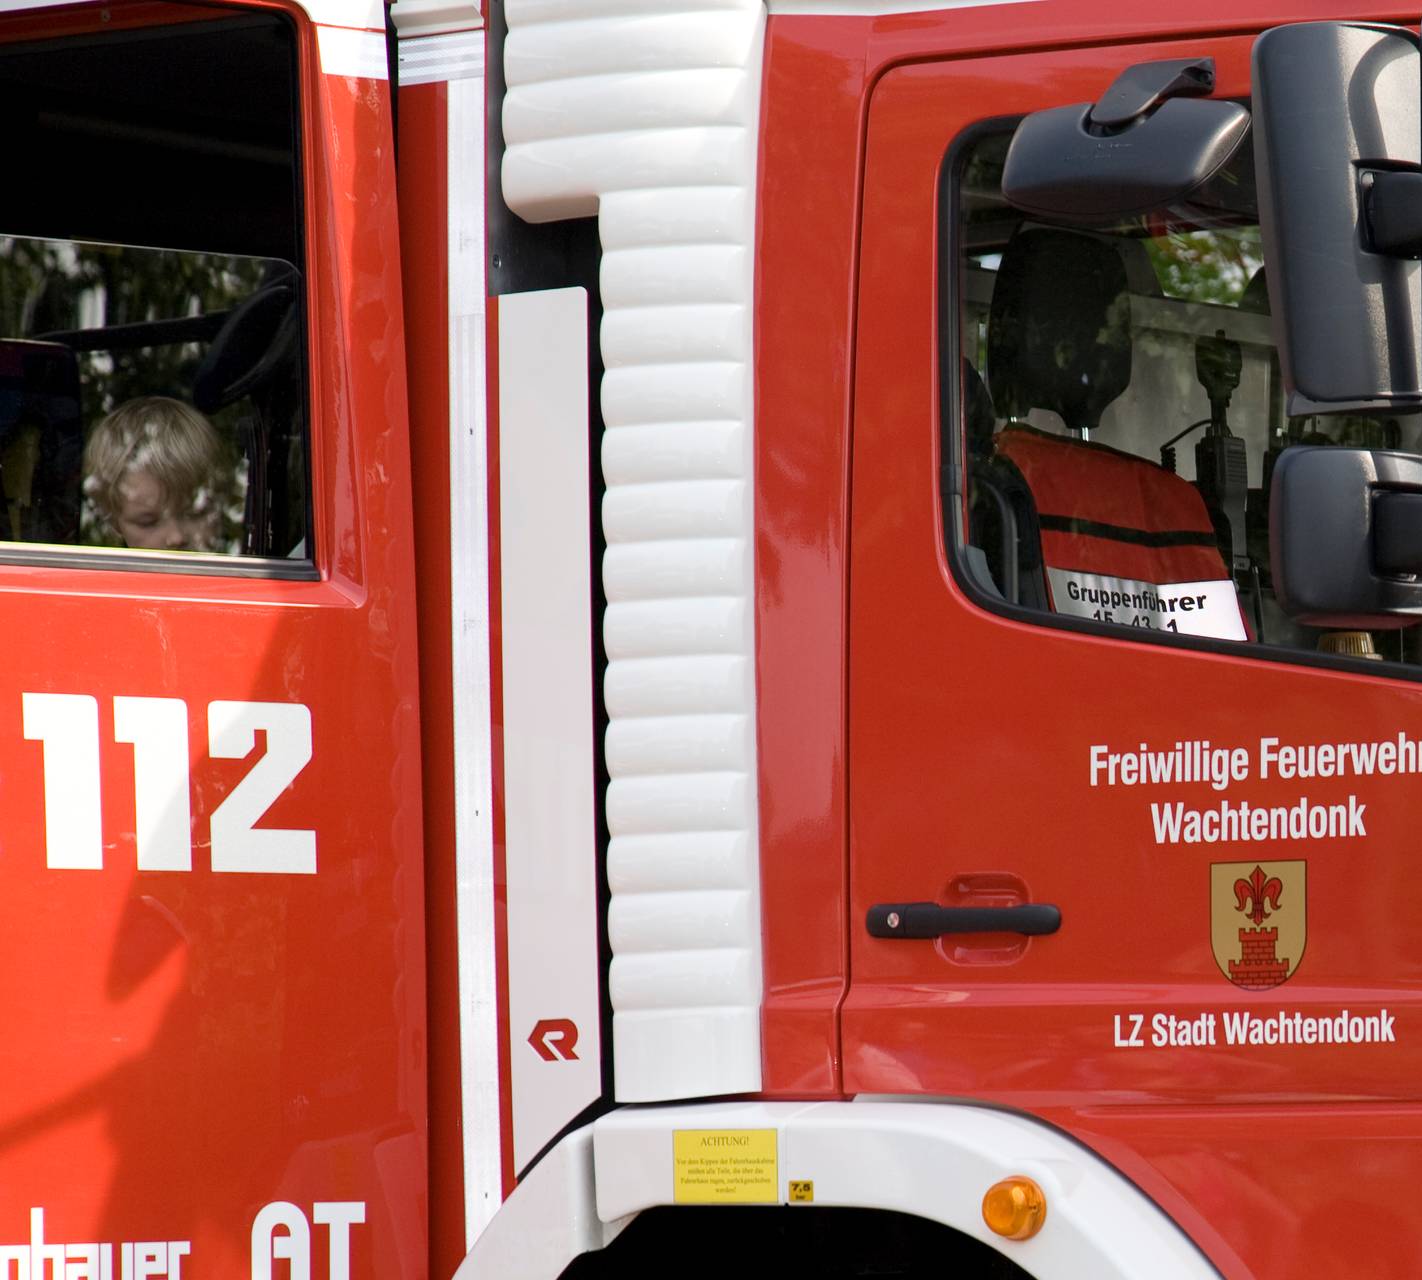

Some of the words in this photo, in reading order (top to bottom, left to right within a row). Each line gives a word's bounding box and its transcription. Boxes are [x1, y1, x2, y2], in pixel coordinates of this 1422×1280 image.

[1067, 581, 1207, 613] Gruppenführer
[22, 693, 317, 875] 112
[1089, 741, 1249, 789] Freiwillige
[1150, 796, 1367, 844] Wachtendonk
[1113, 1014, 1144, 1047] LZ
[1152, 1012, 1217, 1046] Stadt
[1222, 1009, 1396, 1045] Wachtendonk
[700, 1136, 750, 1147] ACHTUNG!
[251, 1201, 366, 1280] AT
